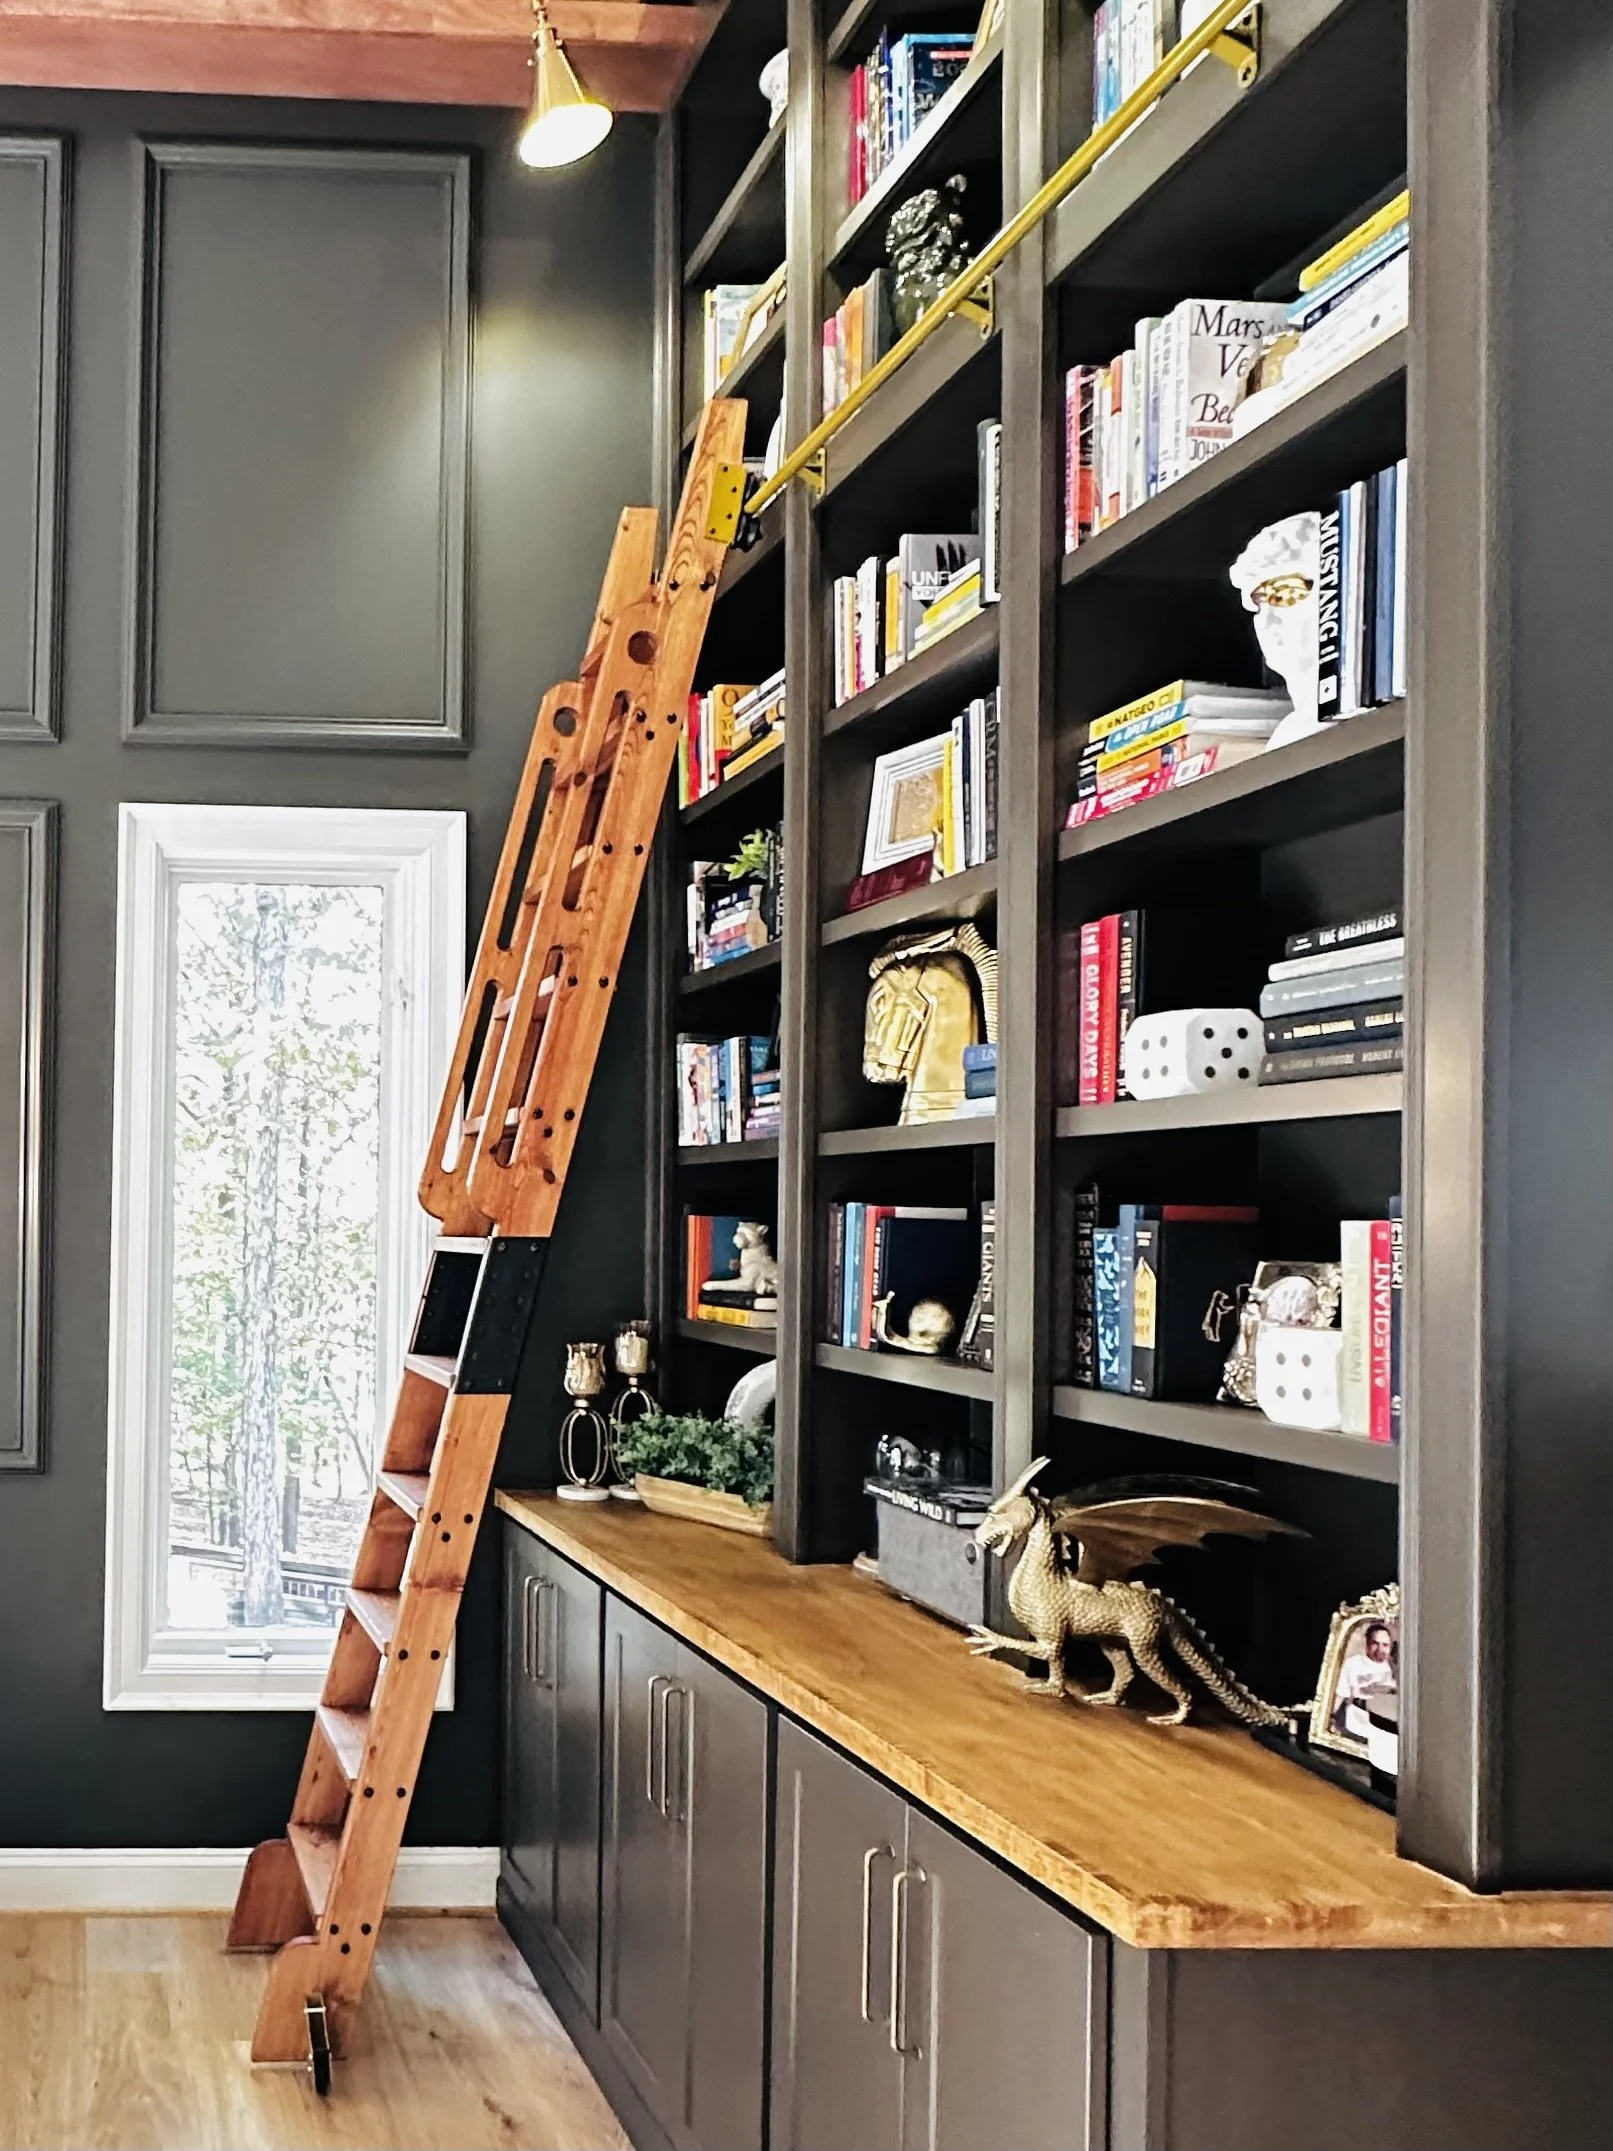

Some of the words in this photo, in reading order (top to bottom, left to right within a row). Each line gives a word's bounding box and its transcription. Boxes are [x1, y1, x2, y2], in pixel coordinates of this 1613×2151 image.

[1191, 304, 1264, 339] Mars
[911, 570, 952, 586] UNF
[1320, 510, 1340, 642] MUSTANG
[1119, 936, 1134, 995] AVENGER
[1083, 963, 1100, 1026] GLORY
[1082, 1029, 1099, 1081] DAYS
[919, 1499, 944, 1521] WILD
